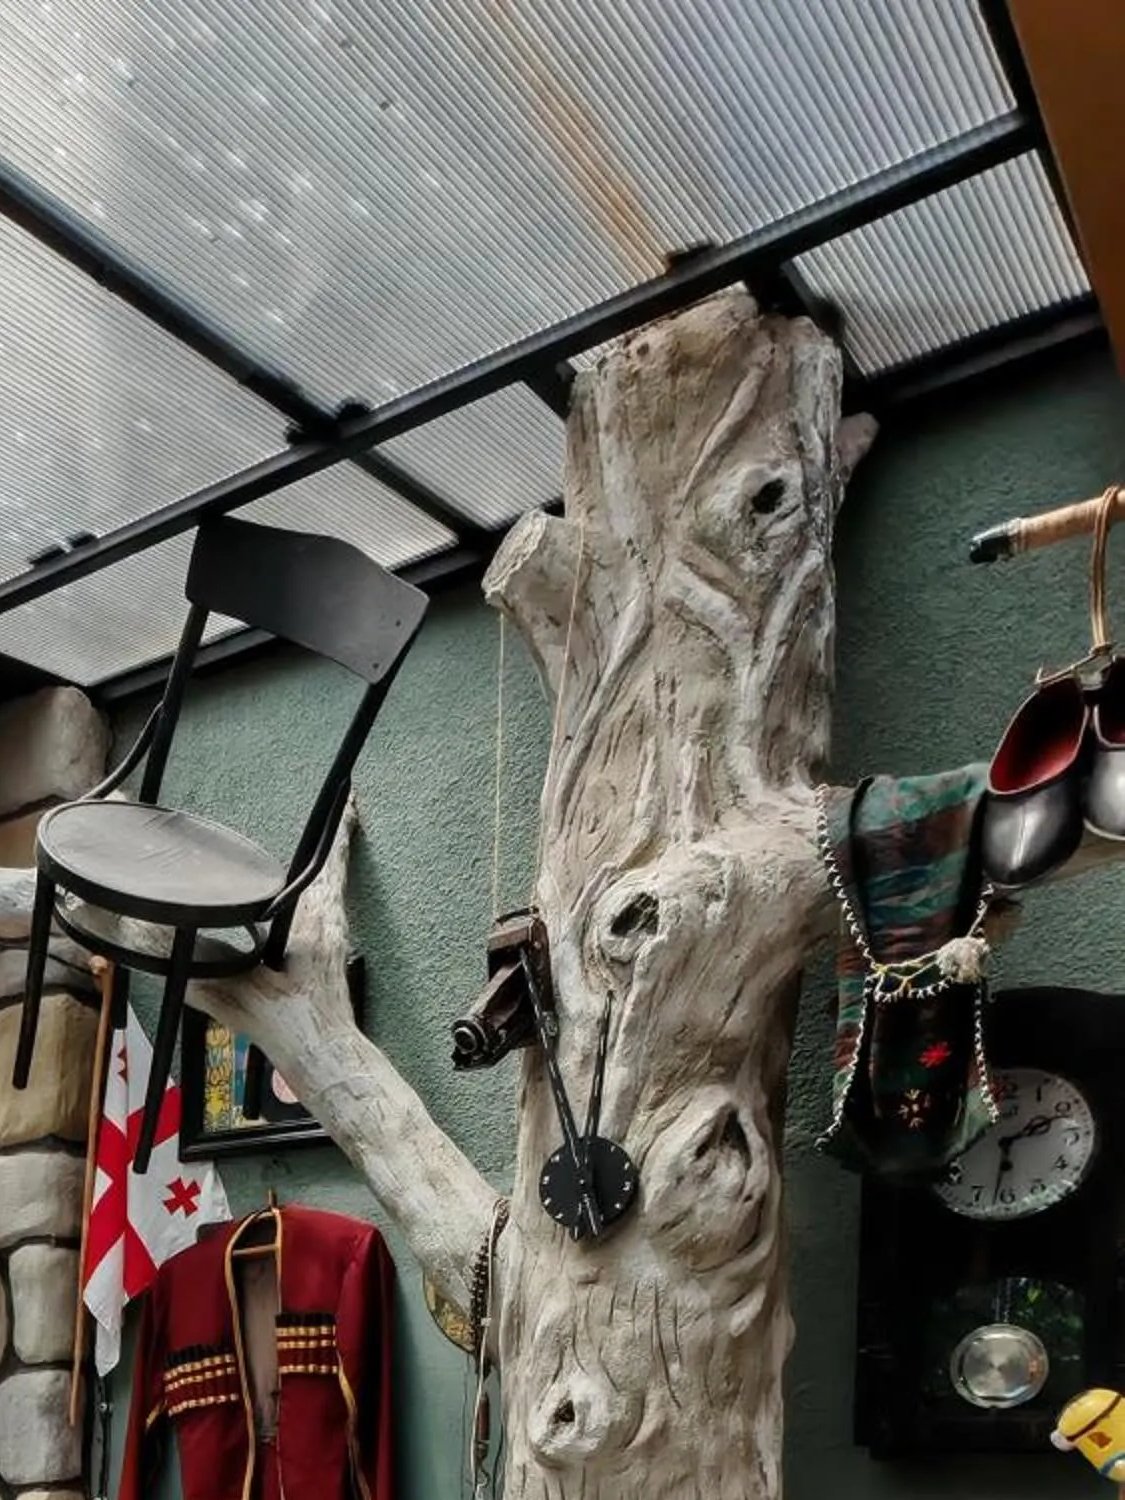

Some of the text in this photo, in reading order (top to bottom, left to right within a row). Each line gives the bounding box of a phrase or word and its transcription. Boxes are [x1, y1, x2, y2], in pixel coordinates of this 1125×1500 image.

[1036, 1085, 1042, 1102] 1
[1053, 1154, 1068, 1170] 4
[971, 1185, 984, 1202] 7
[999, 1188, 1015, 1204] 6
